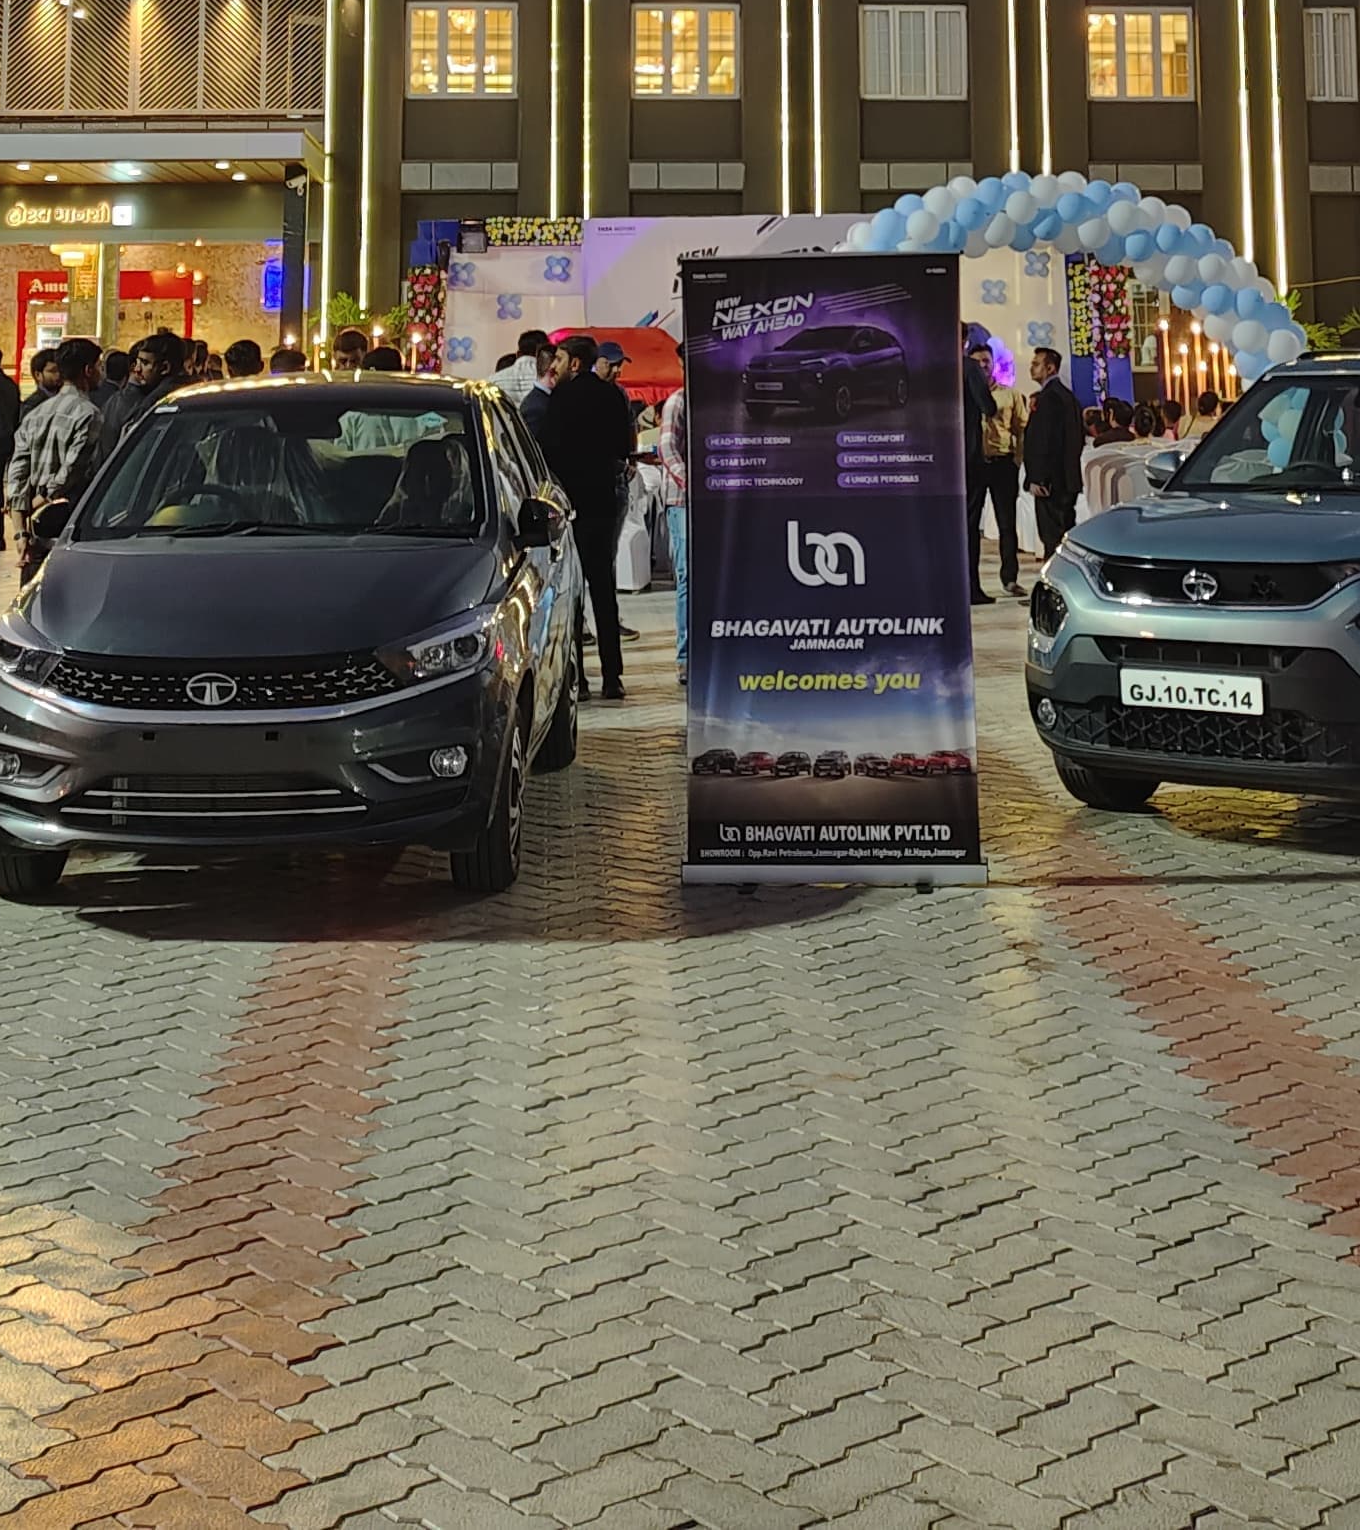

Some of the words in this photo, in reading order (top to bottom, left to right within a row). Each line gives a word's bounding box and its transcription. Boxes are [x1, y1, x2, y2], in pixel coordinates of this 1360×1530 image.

[28, 278, 68, 295] Amu
[712, 292, 814, 327] NEXON
[715, 295, 741, 310] NEW
[722, 324, 751, 341] WAY
[754, 313, 805, 335] AHEAD
[710, 618, 830, 638] BHAGAVATI
[835, 617, 945, 636] AUTOLINK
[789, 638, 865, 650] JAMNAGAR
[738, 669, 868, 691] welcomes
[873, 672, 921, 695] you
[1129, 684, 1253, 710] GJ.10.TC.14
[745, 825, 815, 842] BHAGVATI
[819, 824, 892, 841] AUTOLINK
[894, 824, 951, 841] PVT.LTD
